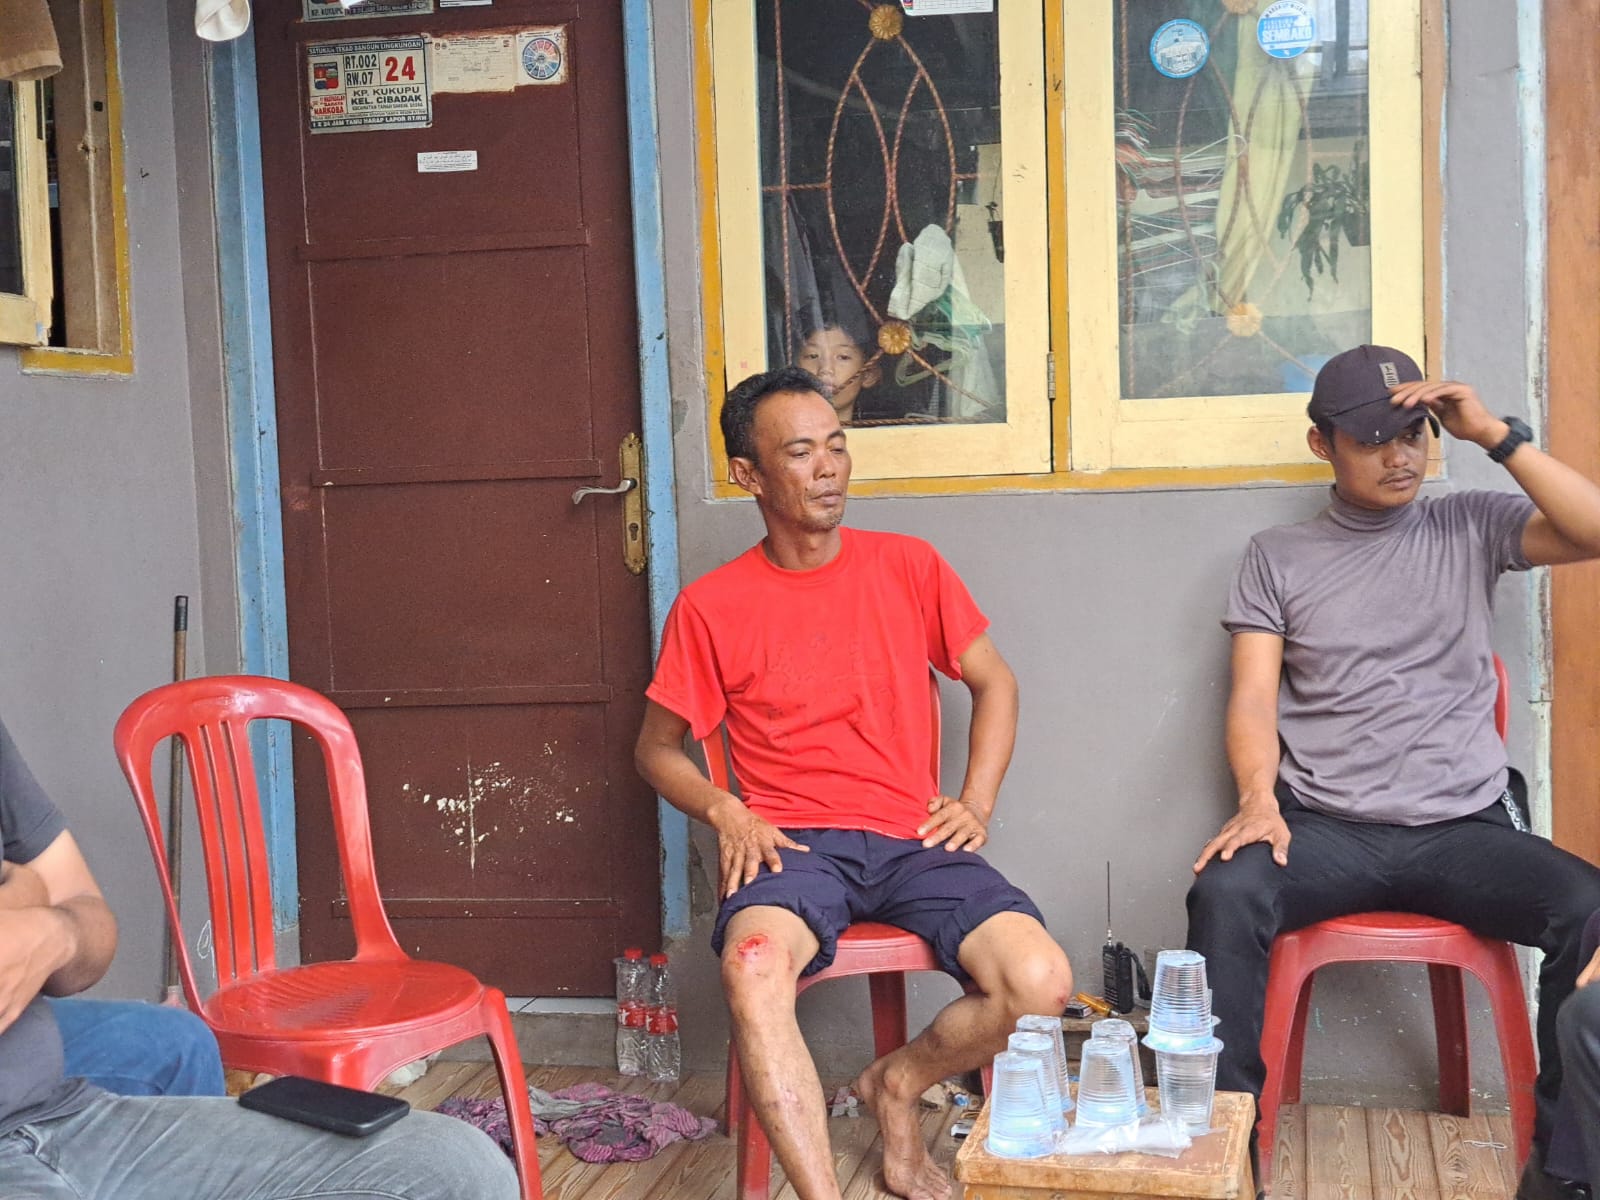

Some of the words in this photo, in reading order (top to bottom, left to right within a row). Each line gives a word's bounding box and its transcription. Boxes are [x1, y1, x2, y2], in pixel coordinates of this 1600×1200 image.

[380, 41, 421, 50] LINGKUNGAN
[345, 54, 377, 70] RT.002
[385, 56, 416, 82] 24
[346, 71, 374, 86] RW.07
[353, 89, 370, 97] KP.
[373, 86, 420, 96] KUKUPU
[351, 96, 374, 106] KEL.
[376, 95, 422, 104] CIBADAK
[314, 106, 344, 115] NARKOBA
